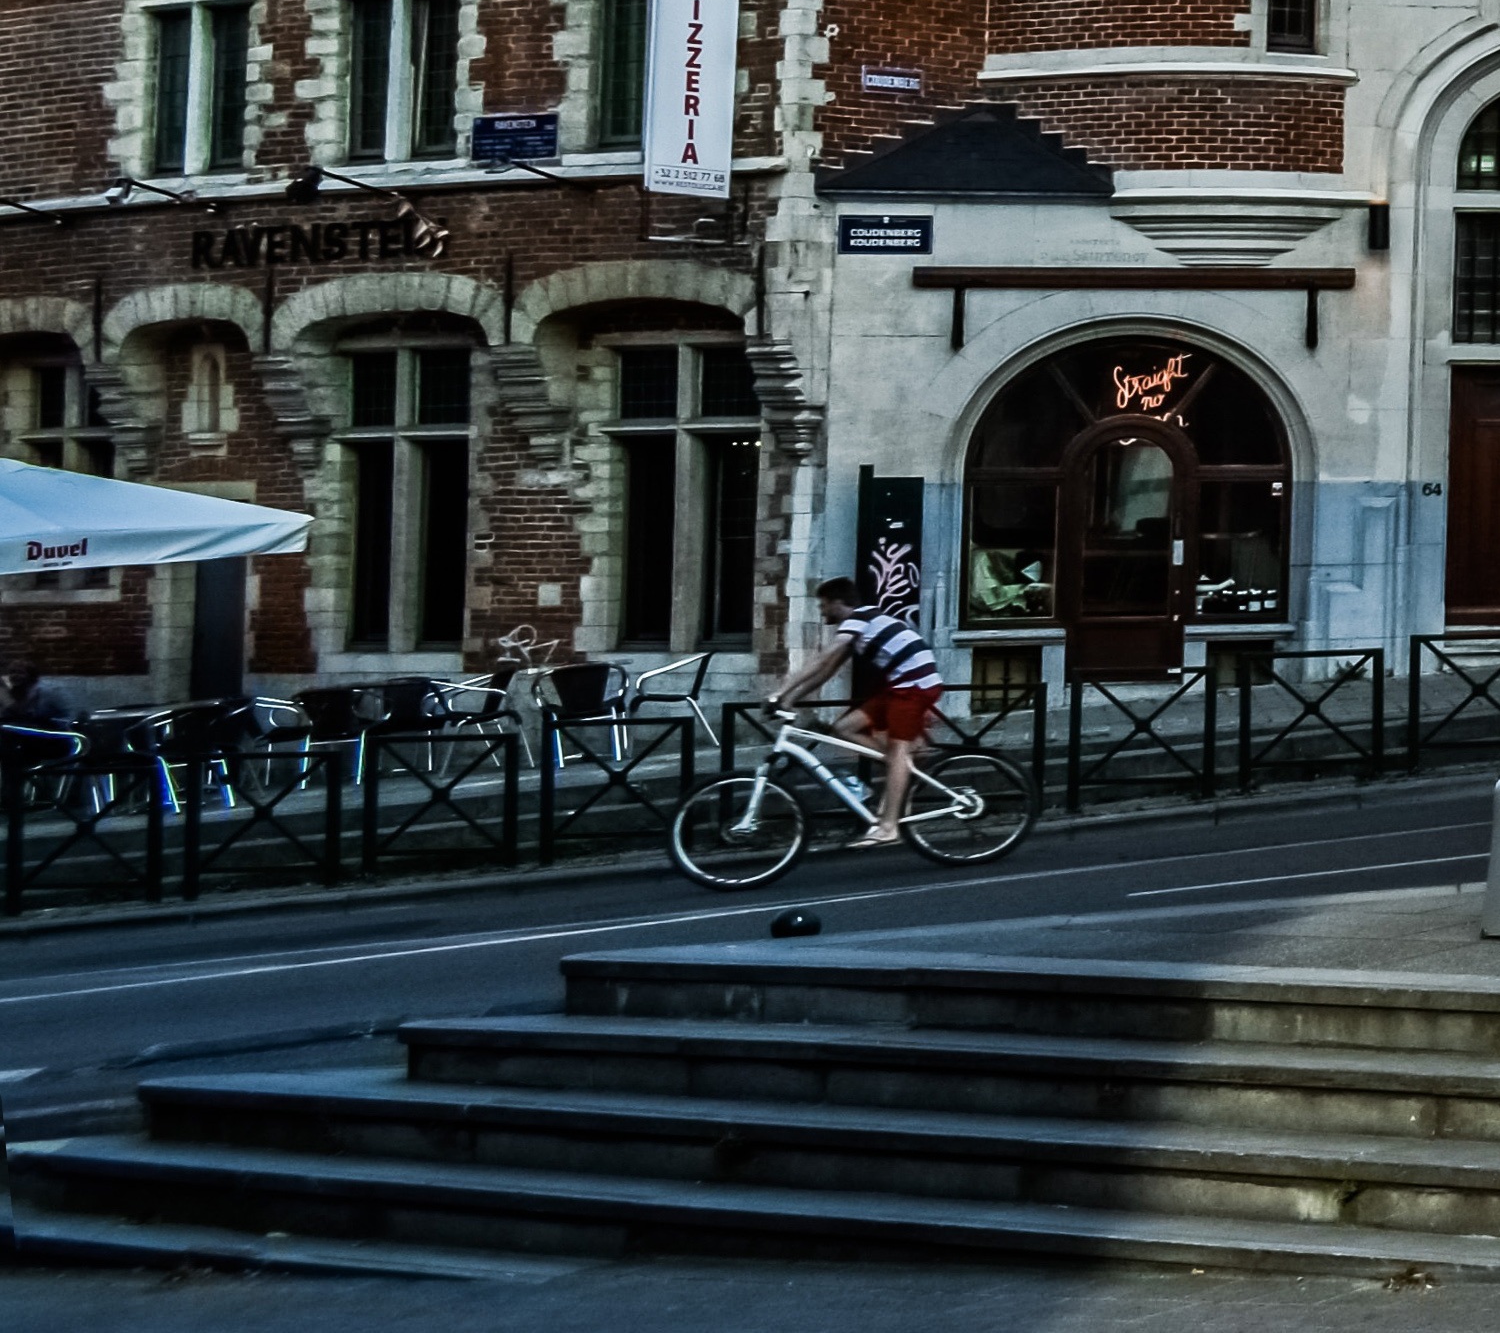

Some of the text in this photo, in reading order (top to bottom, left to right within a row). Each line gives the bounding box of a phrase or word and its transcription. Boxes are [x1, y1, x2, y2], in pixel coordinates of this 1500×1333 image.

[850, 228, 922, 238] COUDENBERG
[191, 217, 448, 269] RAVENSTEI
[1422, 482, 1442, 497] 64
[26, 537, 88, 561] Duvel
